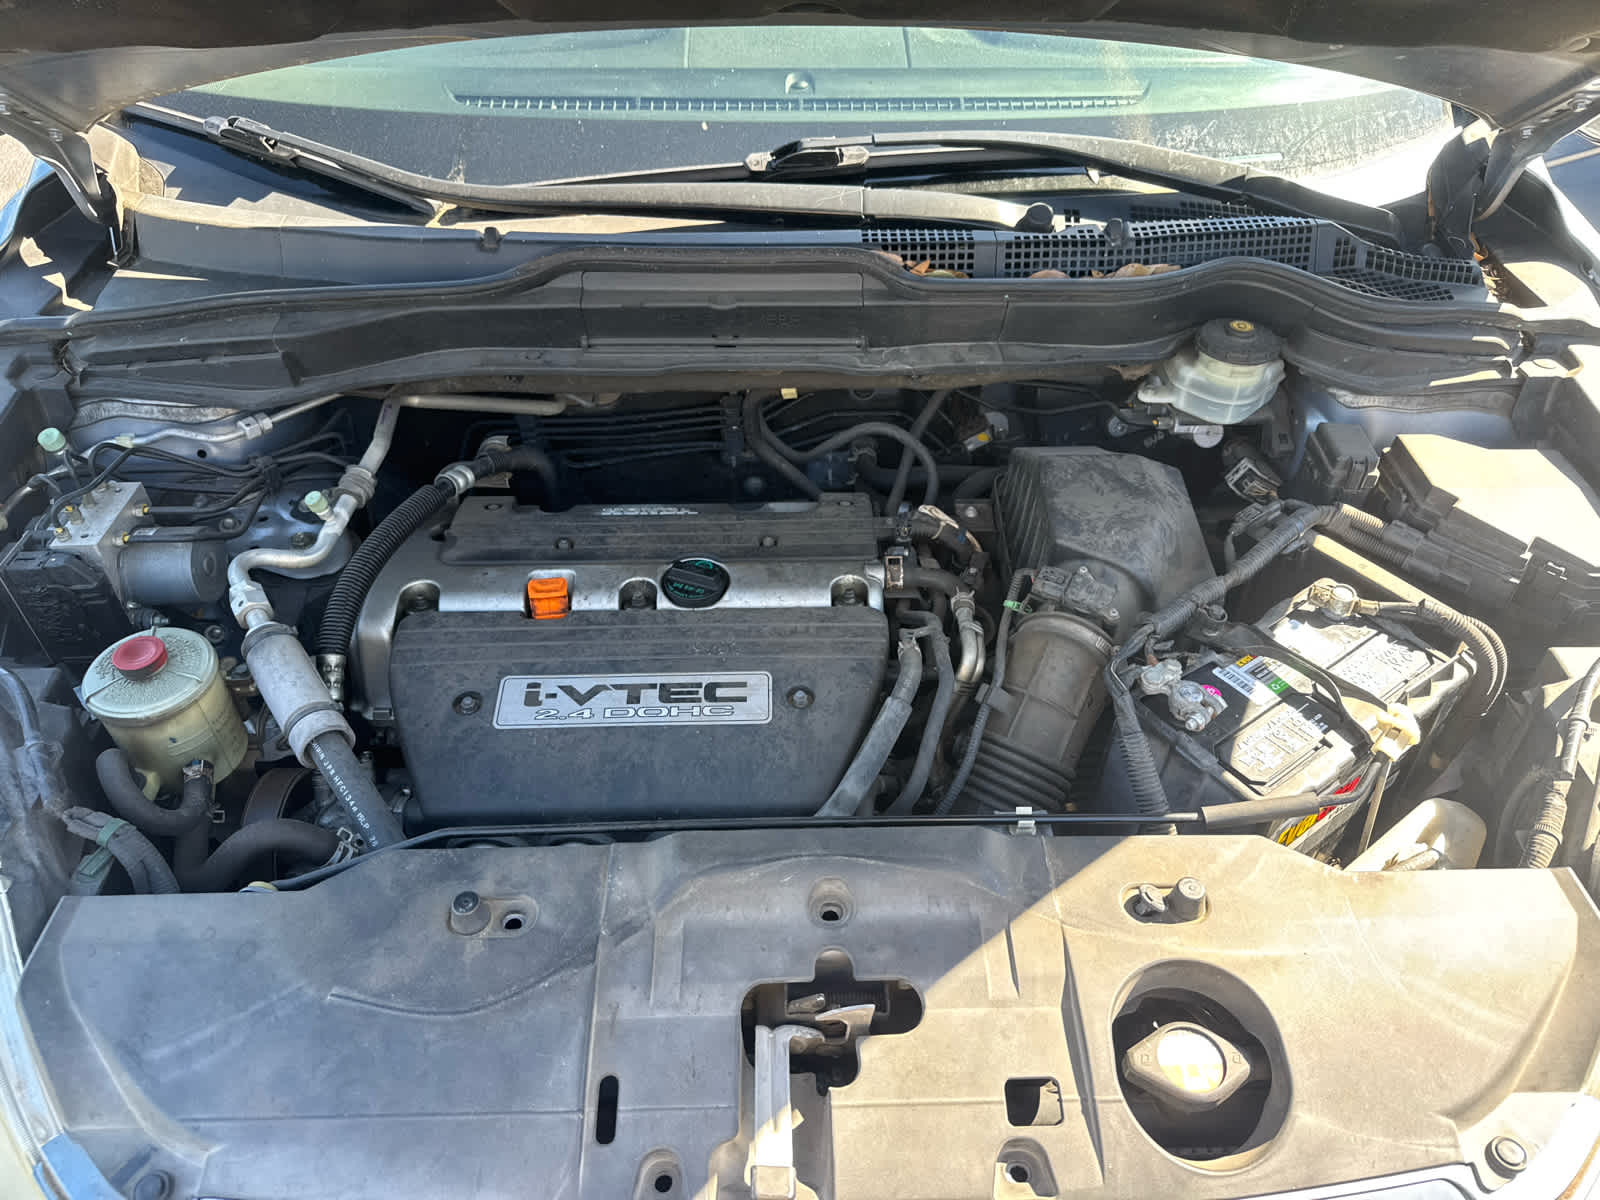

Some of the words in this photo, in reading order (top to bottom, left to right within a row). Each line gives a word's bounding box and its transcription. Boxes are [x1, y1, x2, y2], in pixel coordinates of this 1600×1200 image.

[523, 681, 748, 707] i-VTEC
[534, 708, 595, 721] 2.4
[604, 704, 735, 719] DOHC
